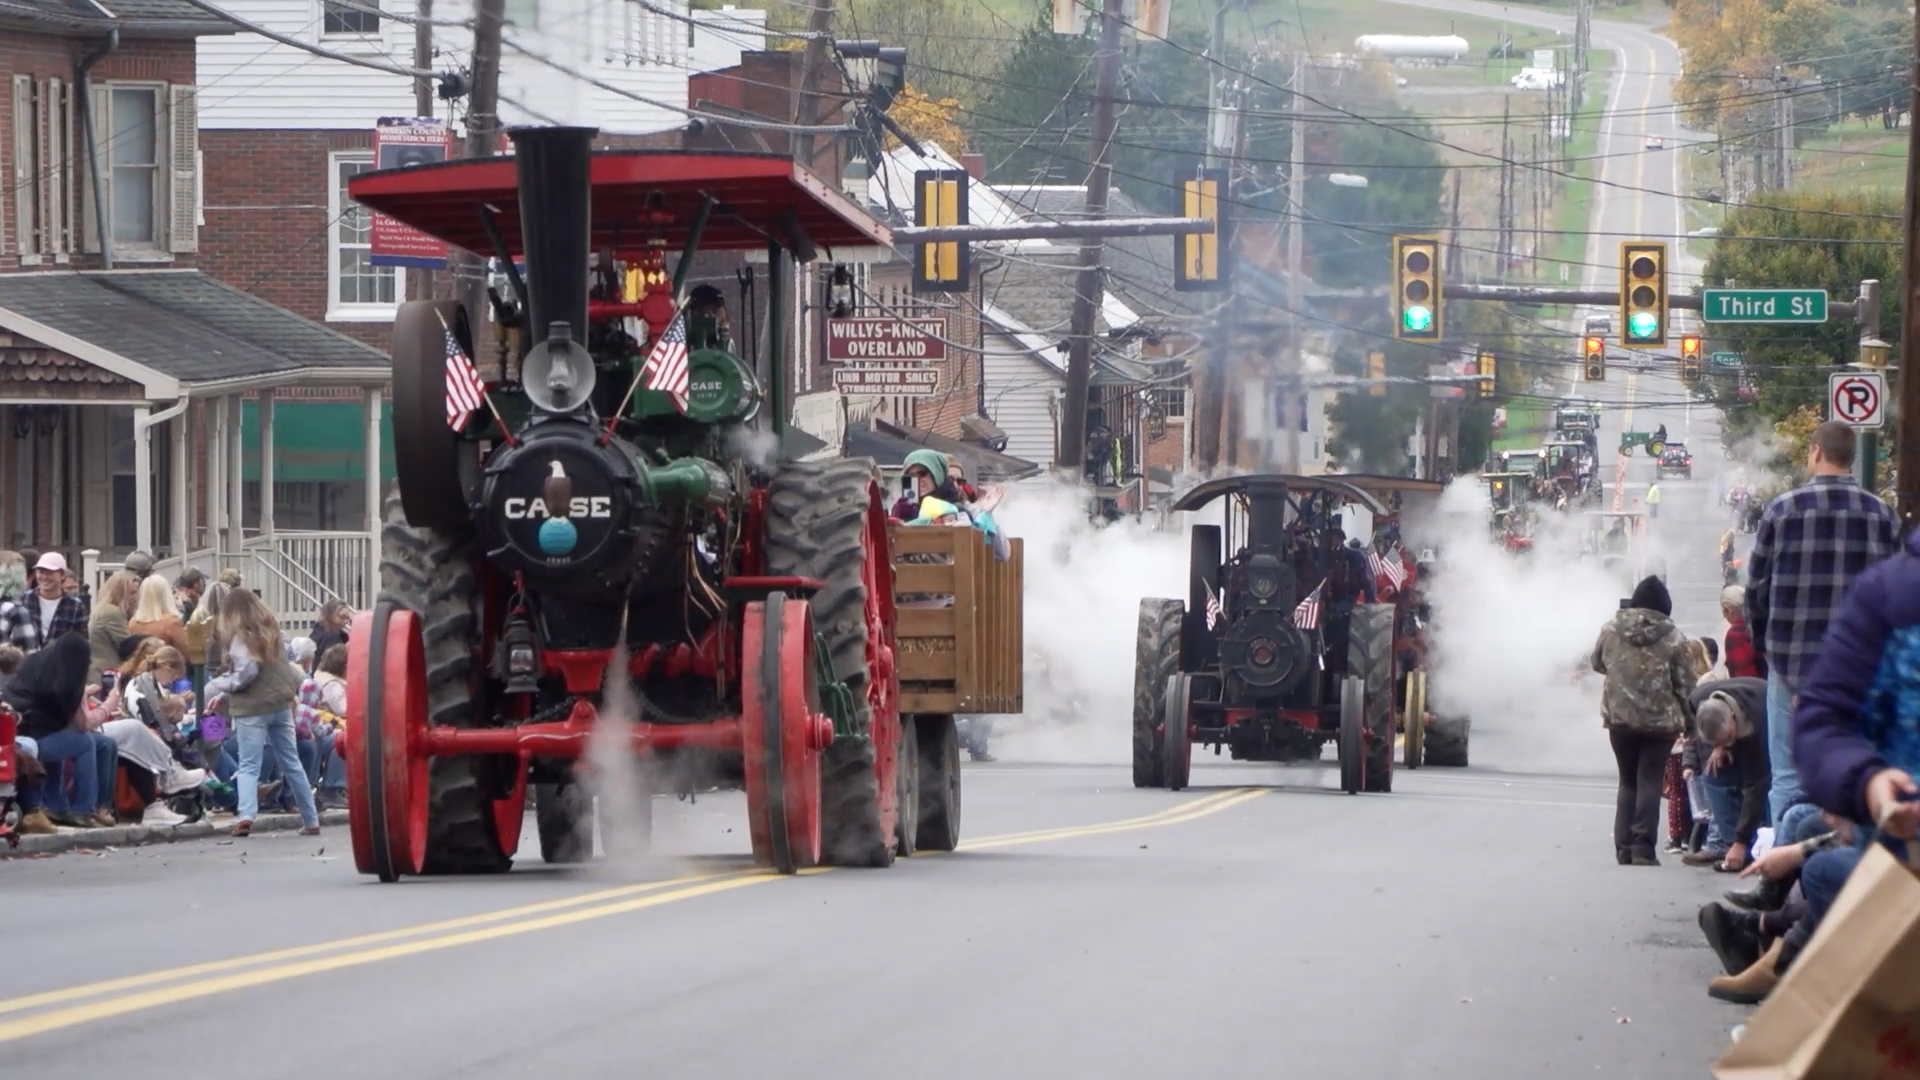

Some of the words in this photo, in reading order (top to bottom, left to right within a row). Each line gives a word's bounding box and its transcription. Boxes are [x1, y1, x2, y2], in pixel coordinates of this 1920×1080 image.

[379, 134, 426, 143] HOMETOWN
[1719, 296, 1776, 316] Third
[1790, 296, 1813, 316] St
[831, 322, 942, 339] WILLYS-KNIGHT
[847, 340, 927, 357] OVERLAND
[690, 381, 723, 391] CASE
[837, 372, 861, 383] LINN
[864, 372, 900, 384] MOTOR
[904, 372, 937, 383] SALES
[504, 496, 611, 519] CASE
